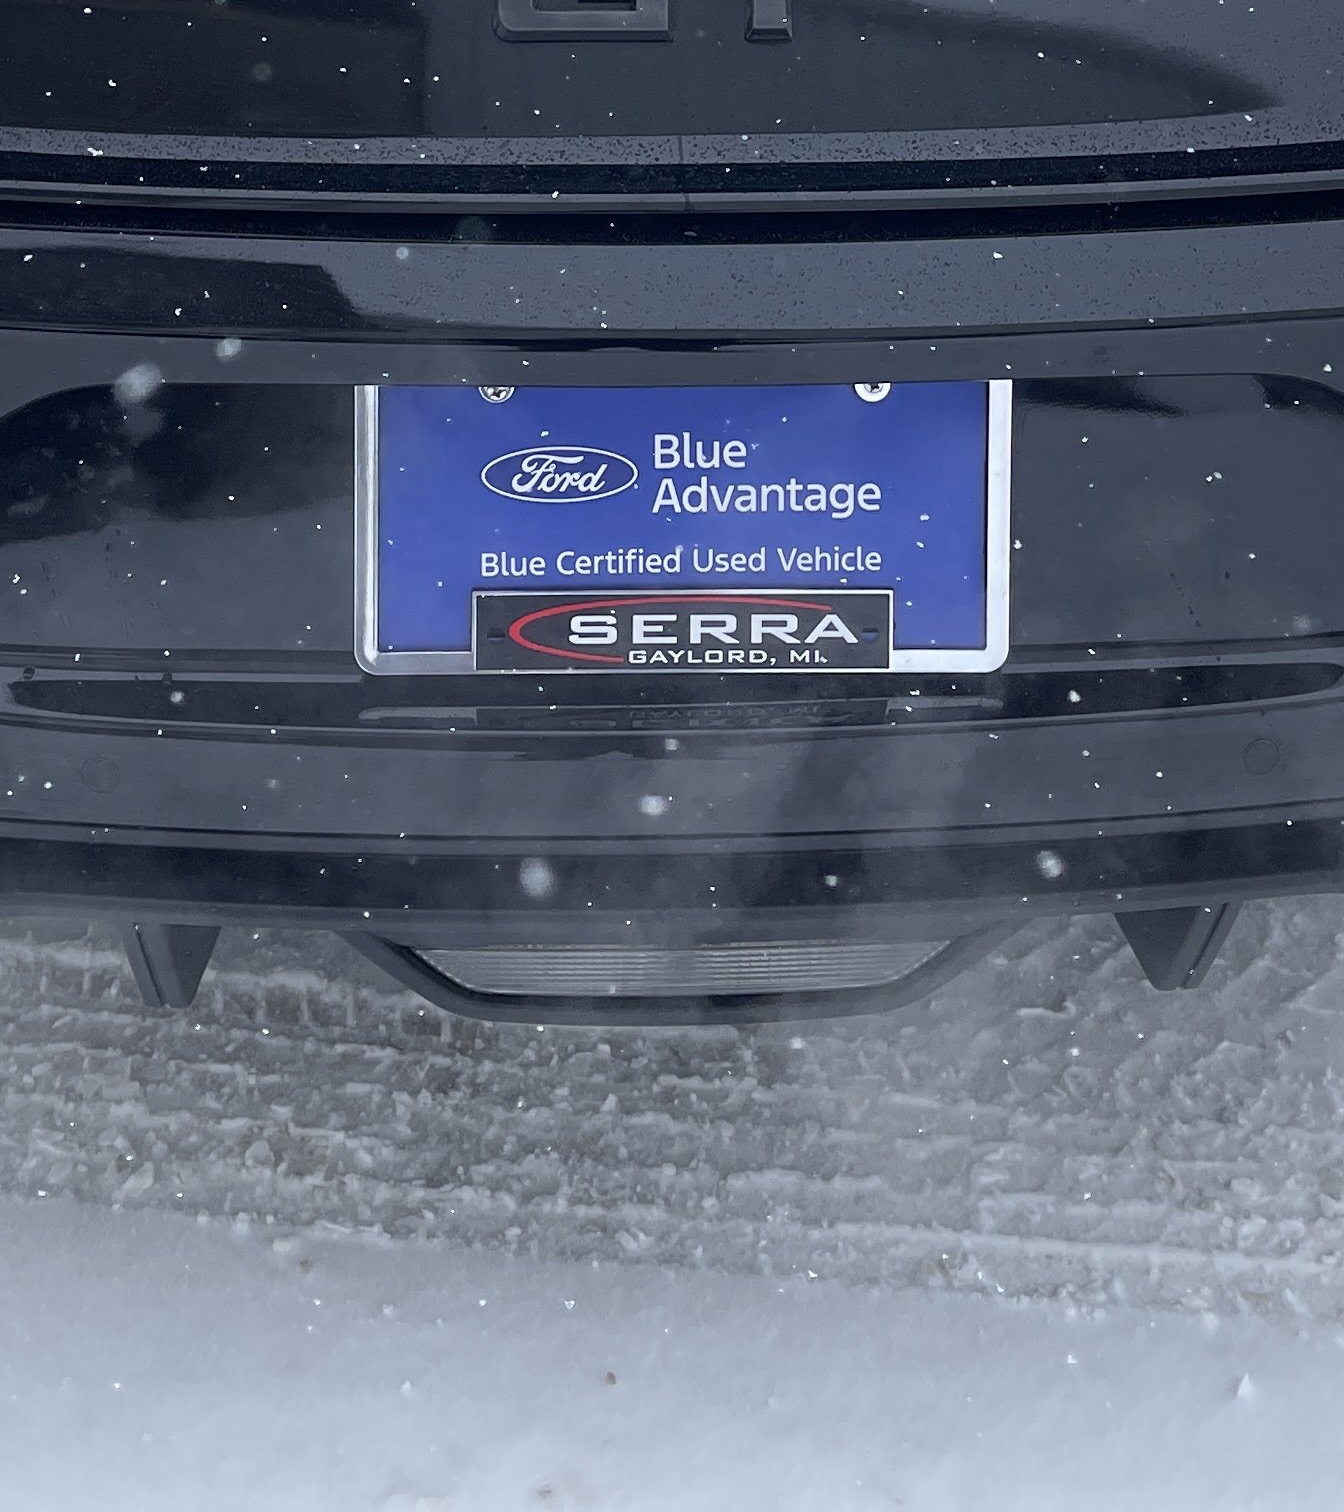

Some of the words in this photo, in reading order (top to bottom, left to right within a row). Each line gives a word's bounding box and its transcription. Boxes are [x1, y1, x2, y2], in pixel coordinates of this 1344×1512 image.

[653, 431, 748, 470] Blue
[511, 454, 609, 493] Ford
[651, 476, 883, 520] Advantage
[480, 551, 547, 578] Blue
[555, 548, 683, 576] Certified
[692, 545, 767, 573] Used
[776, 545, 883, 573] Vehicle
[567, 613, 860, 646] SERRA
[627, 649, 777, 666] GAYLORD,
